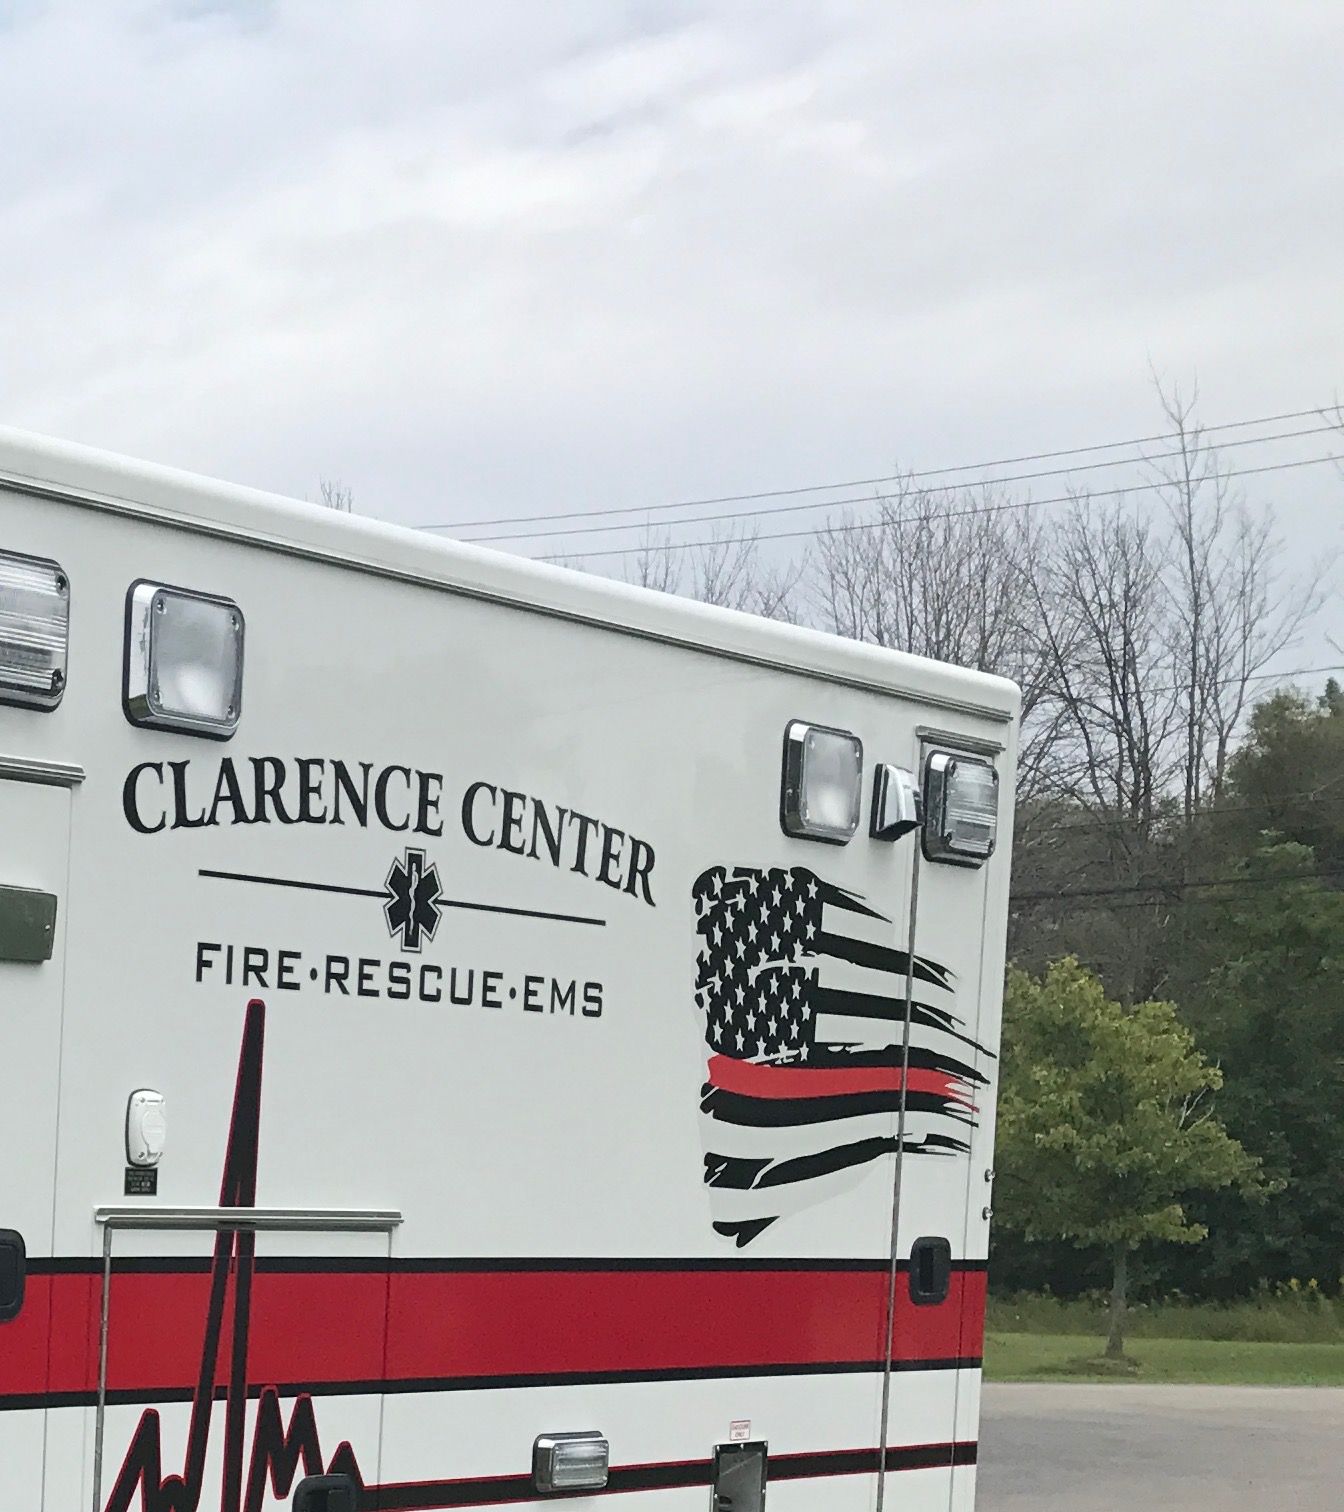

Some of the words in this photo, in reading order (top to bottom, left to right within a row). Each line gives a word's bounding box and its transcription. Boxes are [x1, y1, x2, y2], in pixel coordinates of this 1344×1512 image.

[122, 756, 444, 838] CLARENCE
[461, 781, 657, 908] CENTER
[195, 941, 302, 991] FIRE
[324, 954, 504, 1009] RESCUE
[523, 974, 604, 1018] EMS
